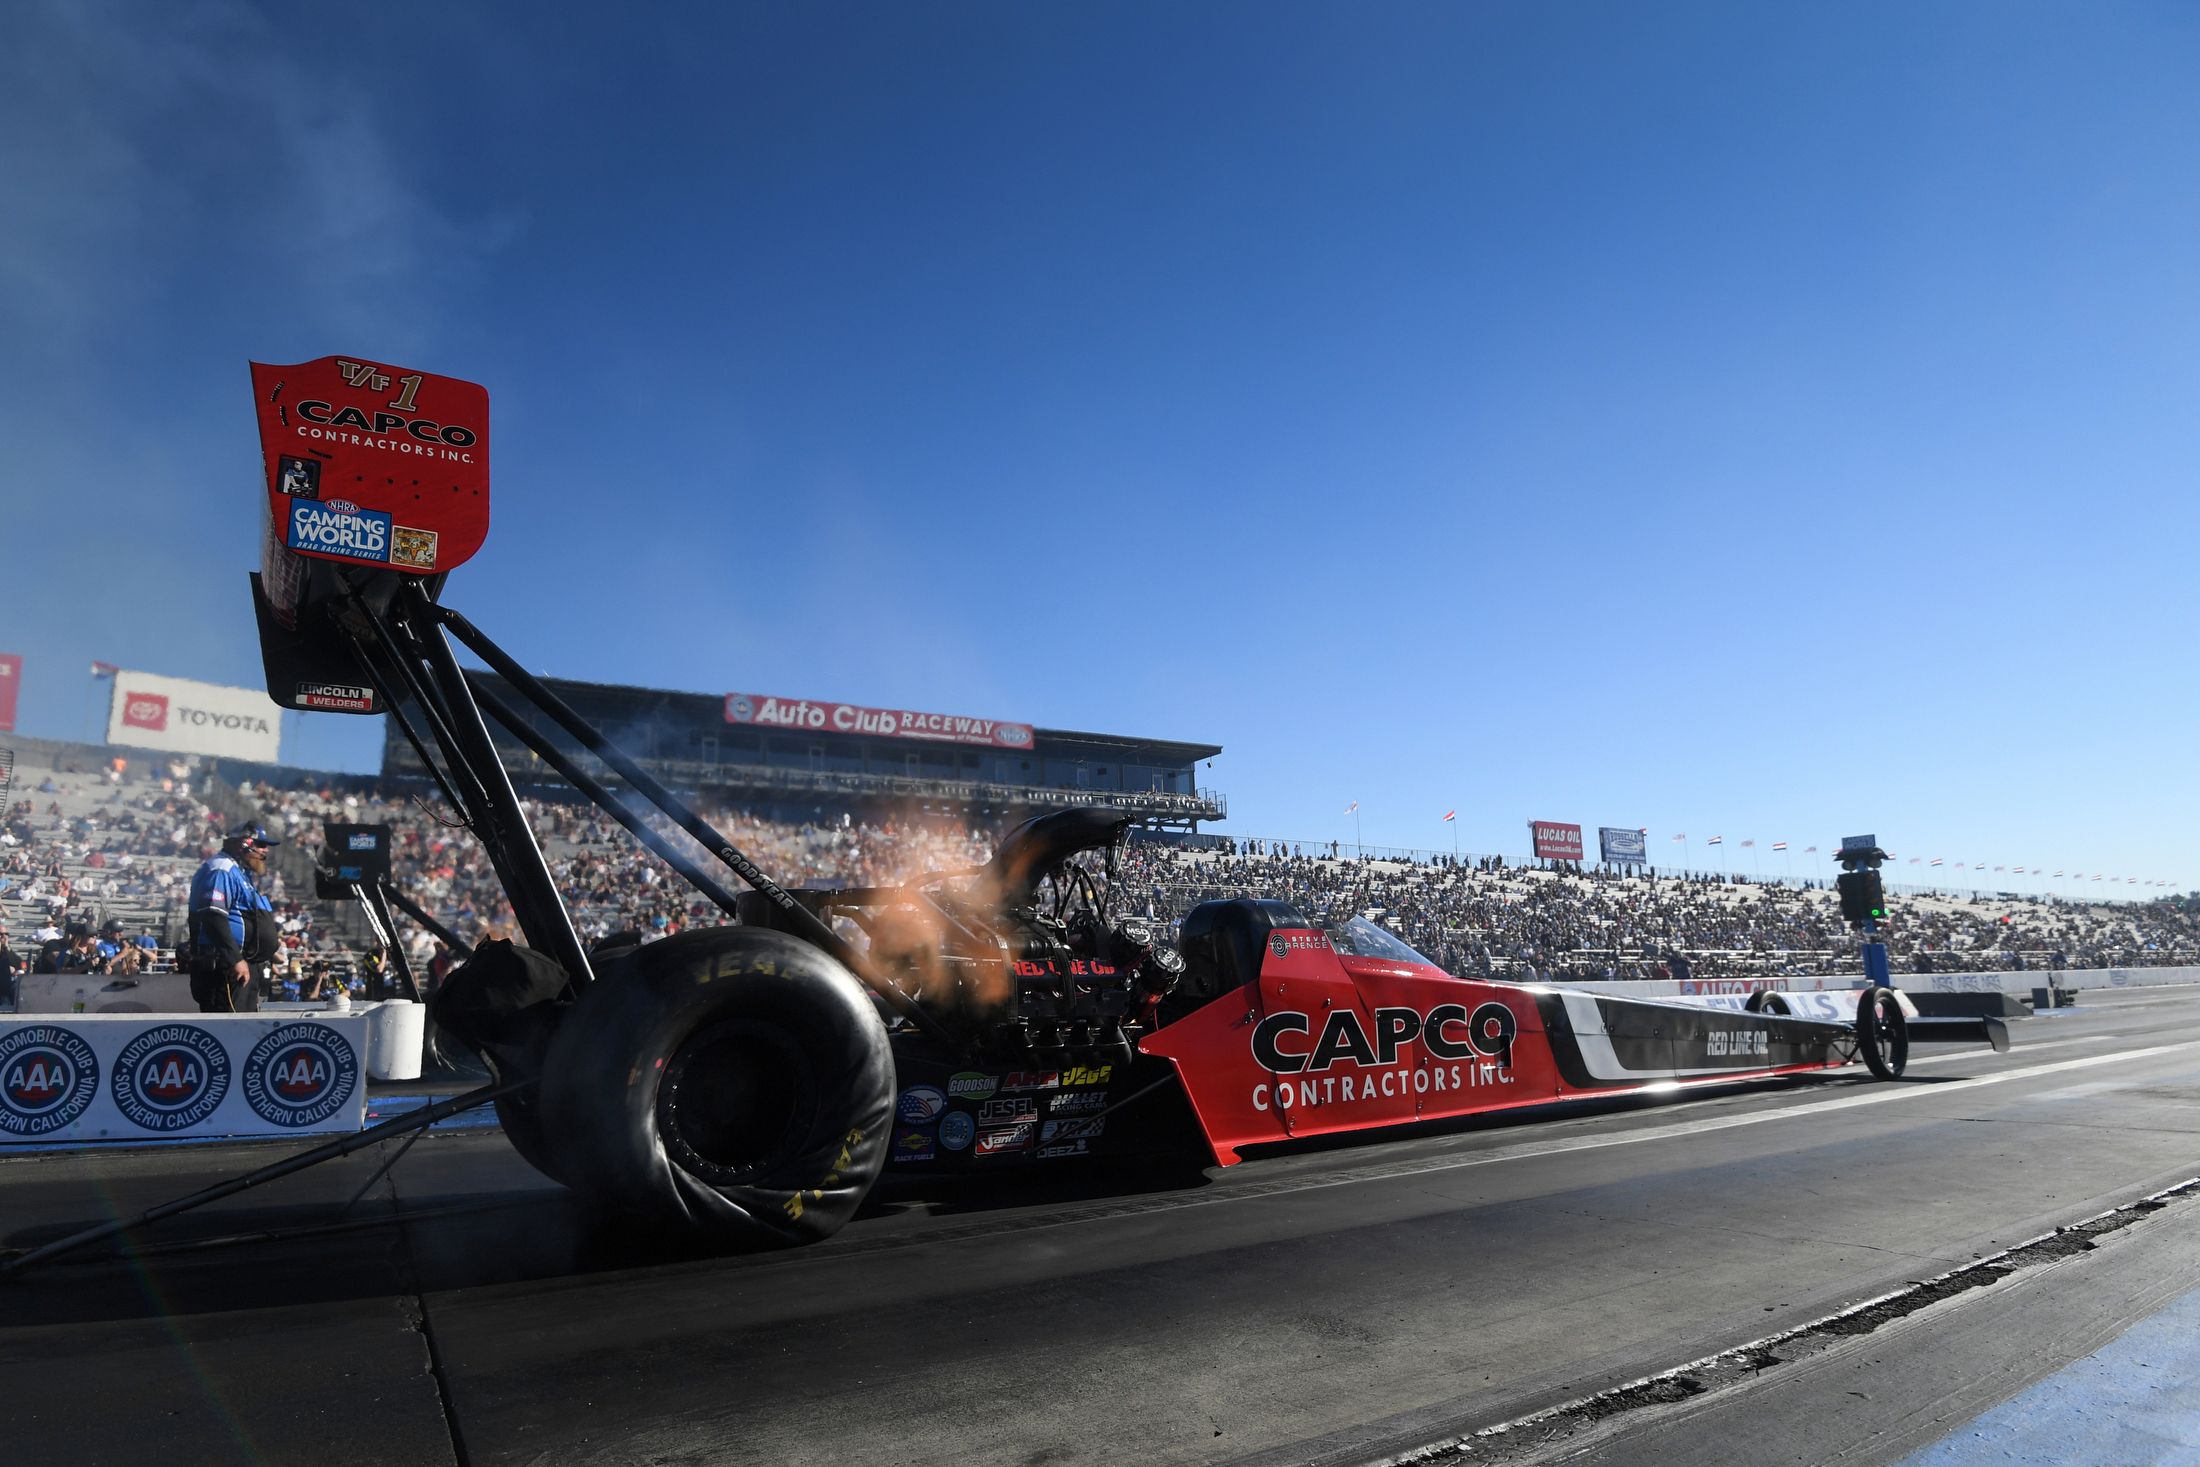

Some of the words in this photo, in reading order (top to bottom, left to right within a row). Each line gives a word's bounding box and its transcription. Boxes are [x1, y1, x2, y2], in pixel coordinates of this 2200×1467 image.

[337, 360, 391, 391] T/F
[389, 375, 423, 412] 1
[297, 400, 477, 447] CAPCO
[298, 426, 435, 457] CONTRACTORS
[440, 450, 475, 464] INC.
[329, 501, 355, 512] NHRA
[295, 508, 385, 535] CAMPING
[295, 522, 385, 551] WORLD
[297, 541, 320, 550] DRAG
[320, 545, 351, 555] RACING
[353, 550, 382, 560] SERIES
[301, 684, 360, 698] LINCOLN
[313, 697, 365, 708] WELDERS
[177, 706, 270, 735] TOYOTA
[755, 698, 826, 727] Auto
[833, 706, 897, 734] Club
[900, 711, 994, 735] RACEWAY
[1537, 827, 1566, 842] LUCAS
[1567, 830, 1581, 843] OIL
[1160, 951, 1176, 966] MSD
[1701, 980, 1746, 995] AUTO
[121, 1028, 201, 1068] AUTOMOBILE
[198, 1037, 225, 1067] CLUB
[252, 1026, 329, 1065] AUTOMOBILE
[326, 1035, 352, 1064] CLUB
[1251, 1001, 1517, 1074] CAPCO
[1707, 1031, 1728, 1056] RED
[1729, 1031, 1753, 1056] LINE
[1753, 1030, 1769, 1055] OIL
[65, 1038, 93, 1069] CLUB
[9, 1063, 65, 1091] AAA
[144, 1061, 198, 1088] AAA
[274, 1059, 326, 1085] AAA
[949, 1077, 998, 1093] GOODSON
[1062, 1065, 1112, 1086] JEGS
[246, 1071, 294, 1124] SOUTHERN
[296, 1070, 354, 1124] CALIFORNIA
[1252, 1065, 1461, 1111] CONTRACTORS
[1470, 1063, 1514, 1087] INC.
[31, 1076, 96, 1132] CALIFORNIA
[115, 1074, 163, 1128] SOUTHERN
[166, 1074, 228, 1128] CALIFORNIA
[979, 1098, 1038, 1119] JESEL
[1037, 1145, 1075, 1158] DEEZ
